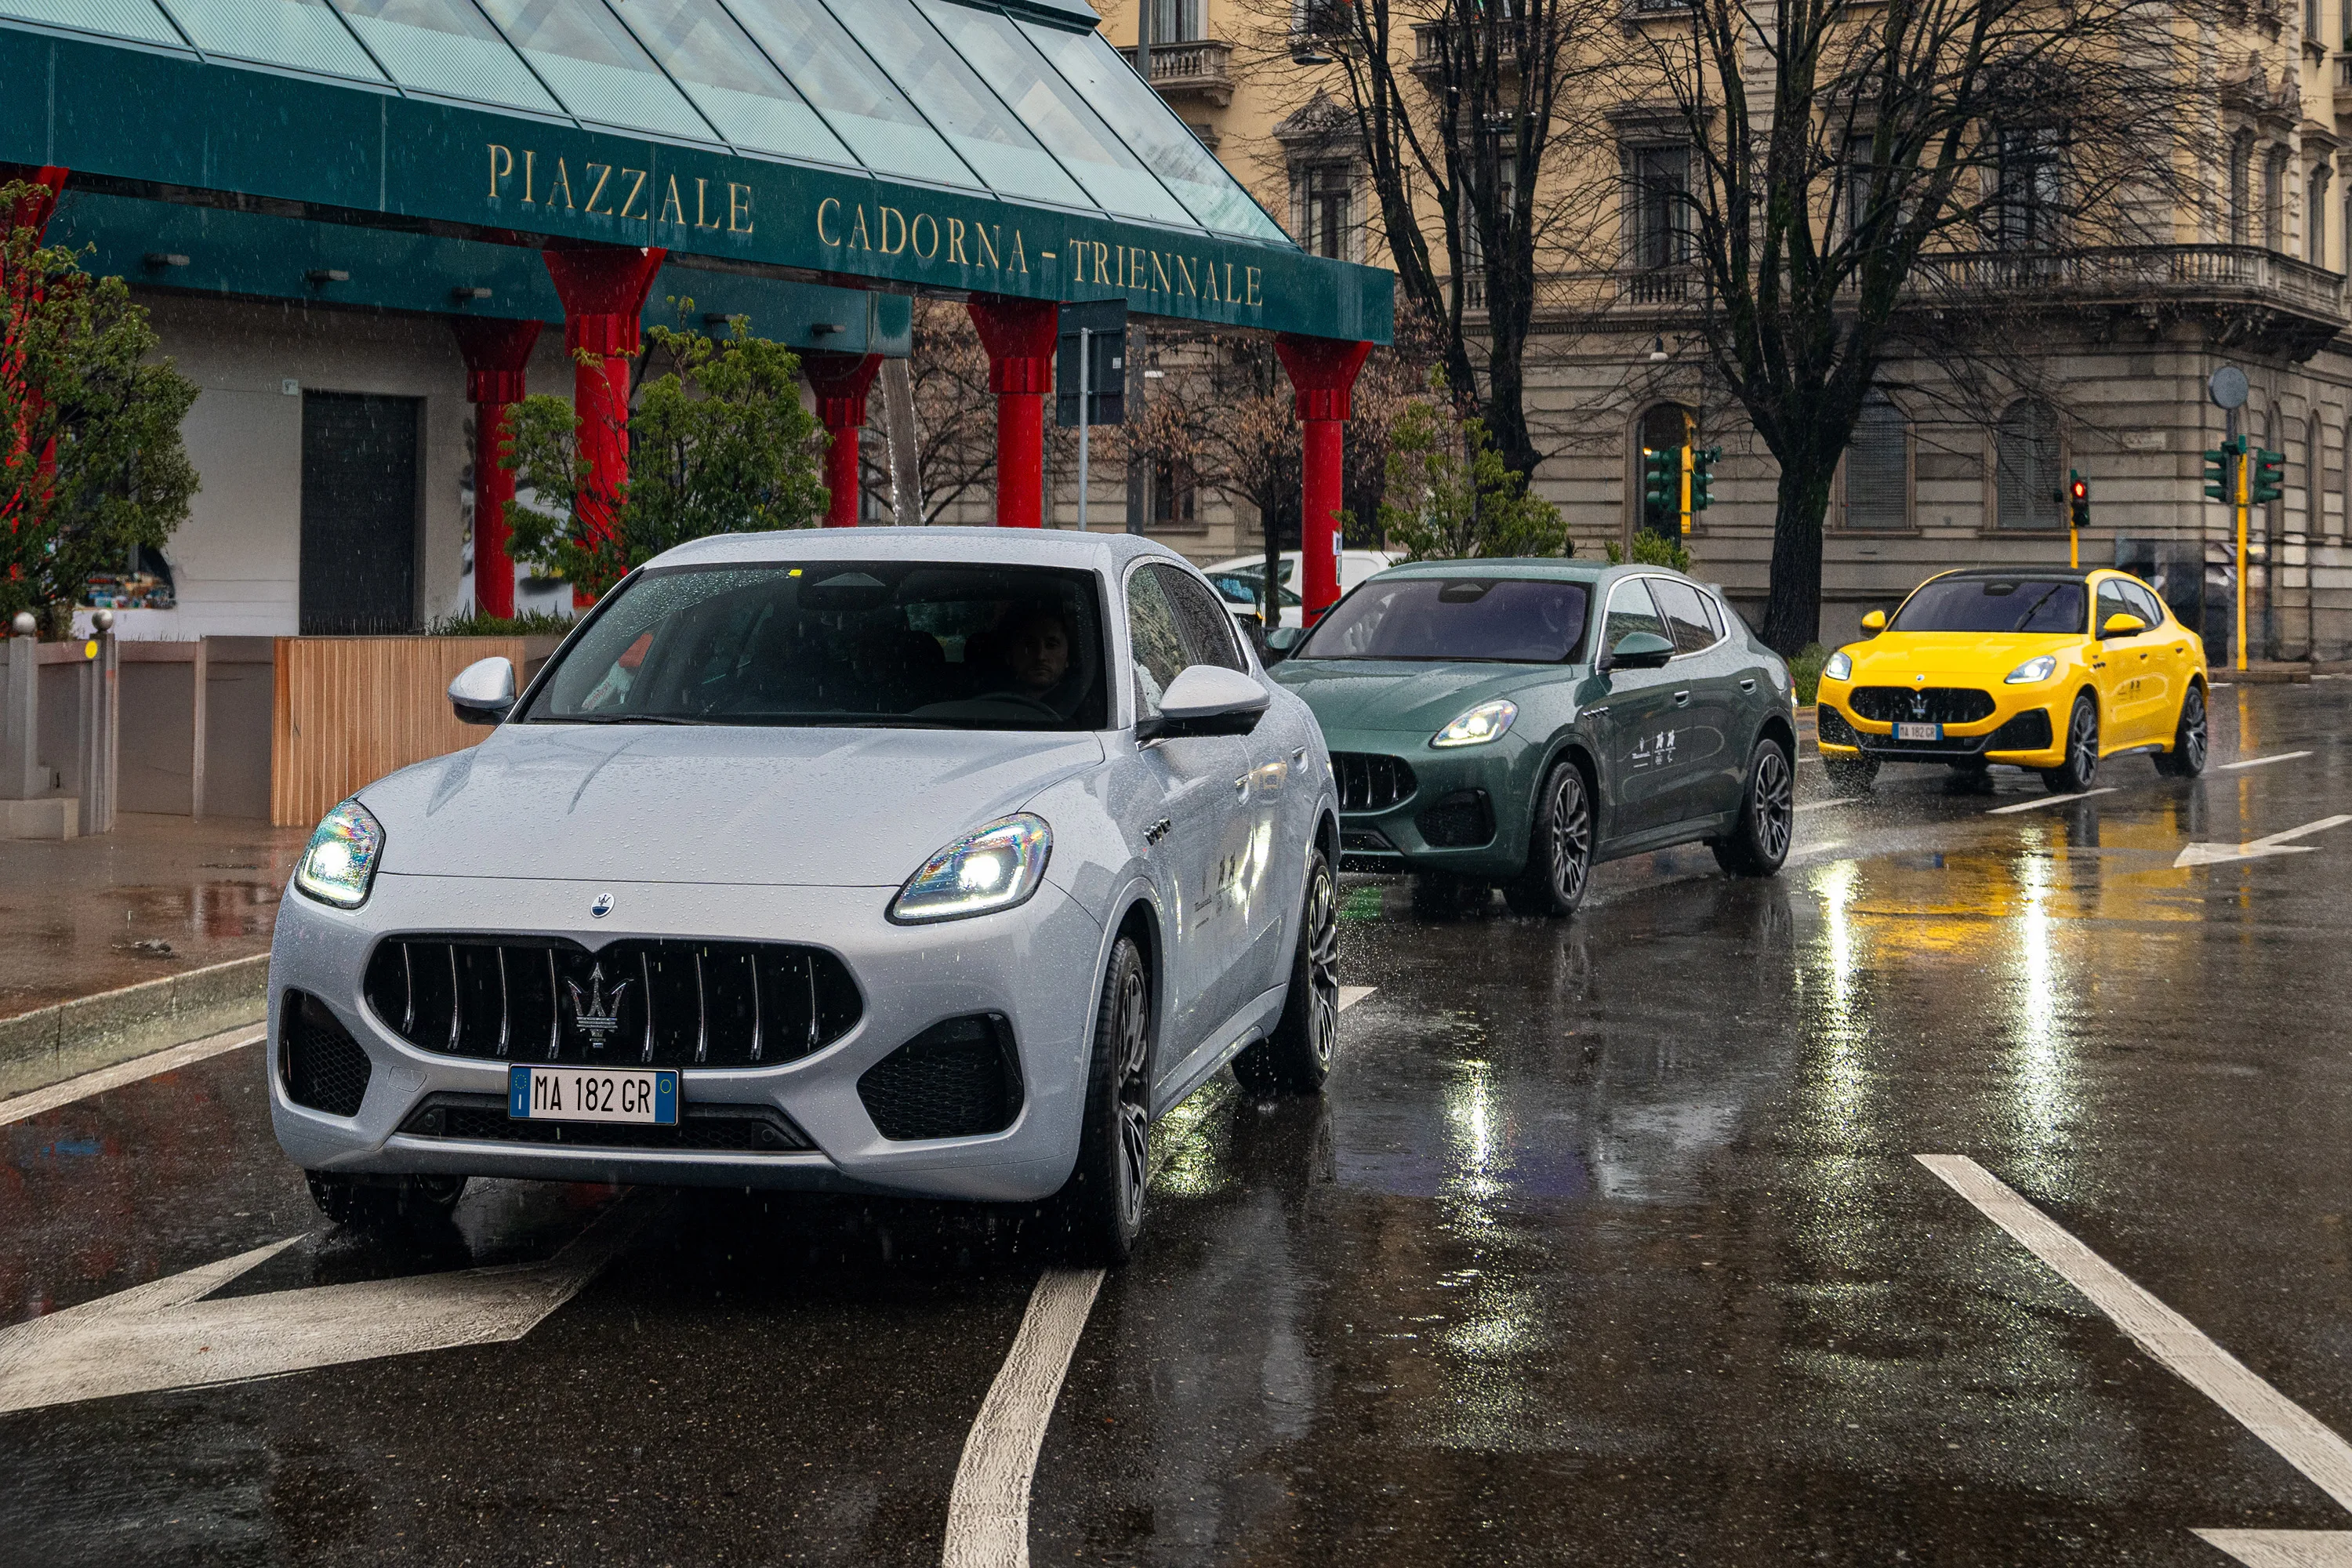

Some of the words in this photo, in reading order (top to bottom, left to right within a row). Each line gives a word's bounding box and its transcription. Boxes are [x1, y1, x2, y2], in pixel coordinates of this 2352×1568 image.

[486, 143, 754, 234] PIAZZALE
[817, 197, 1029, 274] CADORNA
[1069, 237, 1264, 307] TRIENNALE
[534, 1075, 562, 1112] MA
[575, 1076, 614, 1112] 182
[622, 1079, 651, 1114] GR
